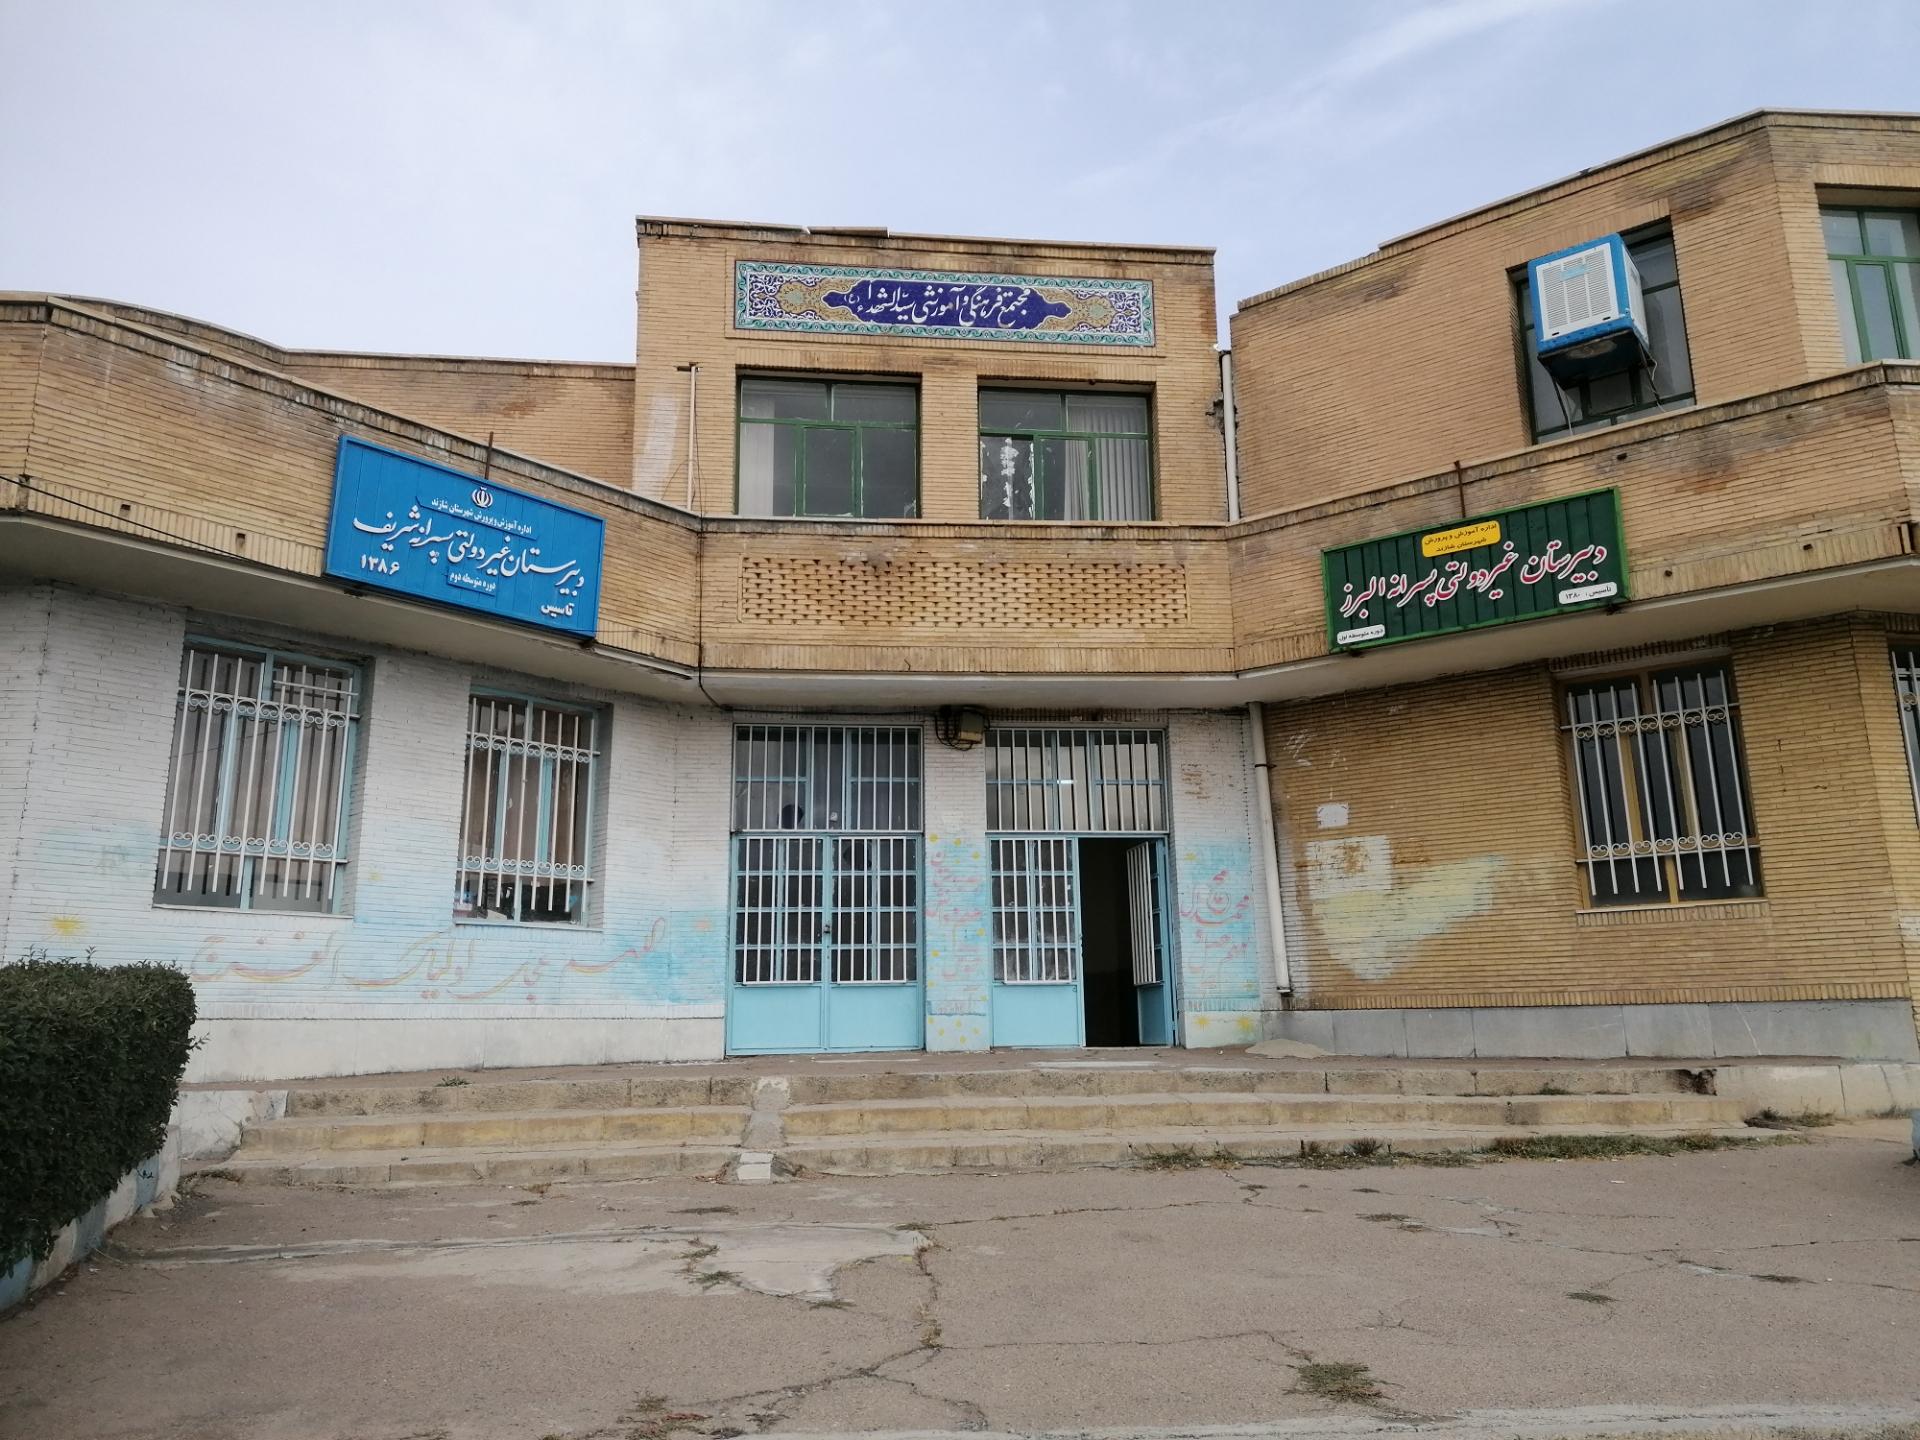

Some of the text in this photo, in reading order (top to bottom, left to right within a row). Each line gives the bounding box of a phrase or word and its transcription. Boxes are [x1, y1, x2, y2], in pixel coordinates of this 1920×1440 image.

[911, 284, 967, 324] آموزشی
[959, 285, 1003, 328] فرهنگی
[962, 294, 970, 306] و
[997, 288, 1031, 329] مجتمع
[431, 497, 448, 510] شازند
[448, 503, 474, 518] شهرستان
[353, 505, 421, 551] شریف
[498, 518, 517, 530] آموزش
[517, 525, 532, 535] اداره
[1454, 526, 1479, 539] آموزش
[1480, 523, 1498, 533] اداره
[408, 518, 454, 565] پسرانه
[1424, 535, 1448, 546] پرورش
[1456, 537, 1487, 549] شهرستان
[500, 547, 585, 597] دبیرستان
[1520, 539, 1608, 585] دبیرستان
[360, 553, 575, 618] تاسیس ۱۳۸۶
[449, 572, 496, 592] دوره متوسطه دوم
[1338, 575, 1387, 619] البرز
[1386, 568, 1438, 608] پسرانه
